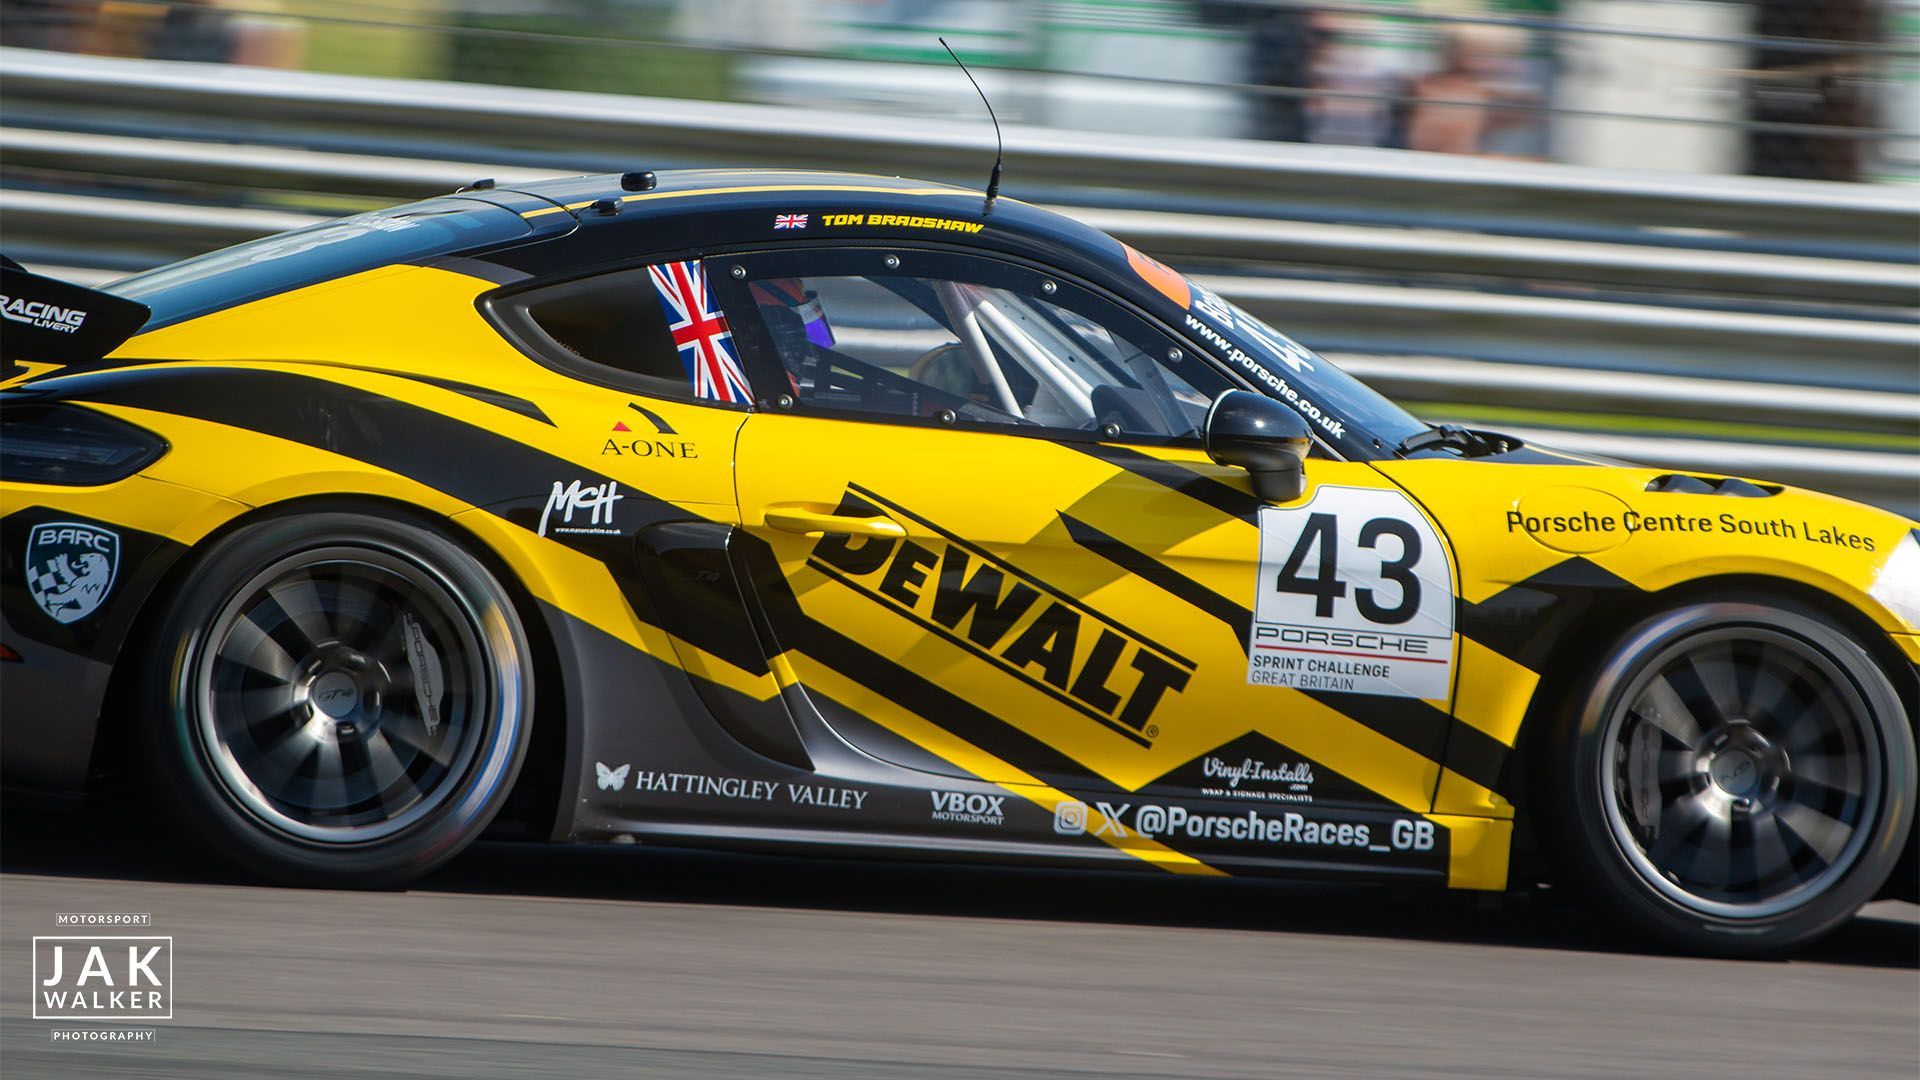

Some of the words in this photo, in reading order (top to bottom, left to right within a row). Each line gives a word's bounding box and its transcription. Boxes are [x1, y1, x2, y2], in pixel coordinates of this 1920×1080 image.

[822, 214, 864, 226] TOM
[867, 214, 984, 234] BRADSHAW
[33, 318, 80, 334] LIVERY
[1185, 313, 1346, 440] www.porsche.co.uk
[601, 439, 698, 459] A-ONE
[38, 529, 110, 553] BARC
[1506, 511, 1615, 533] Porsche
[1623, 511, 1712, 533] Centre
[1720, 513, 1796, 539] South
[1802, 521, 1875, 552] Lakes
[1276, 512, 1422, 625] 43
[1256, 627, 1429, 654] PORSCHE
[1253, 655, 1304, 671] SPRINT
[1308, 659, 1390, 678] CHALLENGE
[1252, 670, 1296, 687] GREAT
[1300, 674, 1355, 690] BRITAIN
[636, 770, 780, 801] HATTINGLEY
[788, 783, 868, 810] VALLEY
[931, 791, 1005, 816] VBOX
[932, 811, 1005, 826] MOTORSPORT
[1136, 804, 1435, 852] @PorscheRaces_GB
